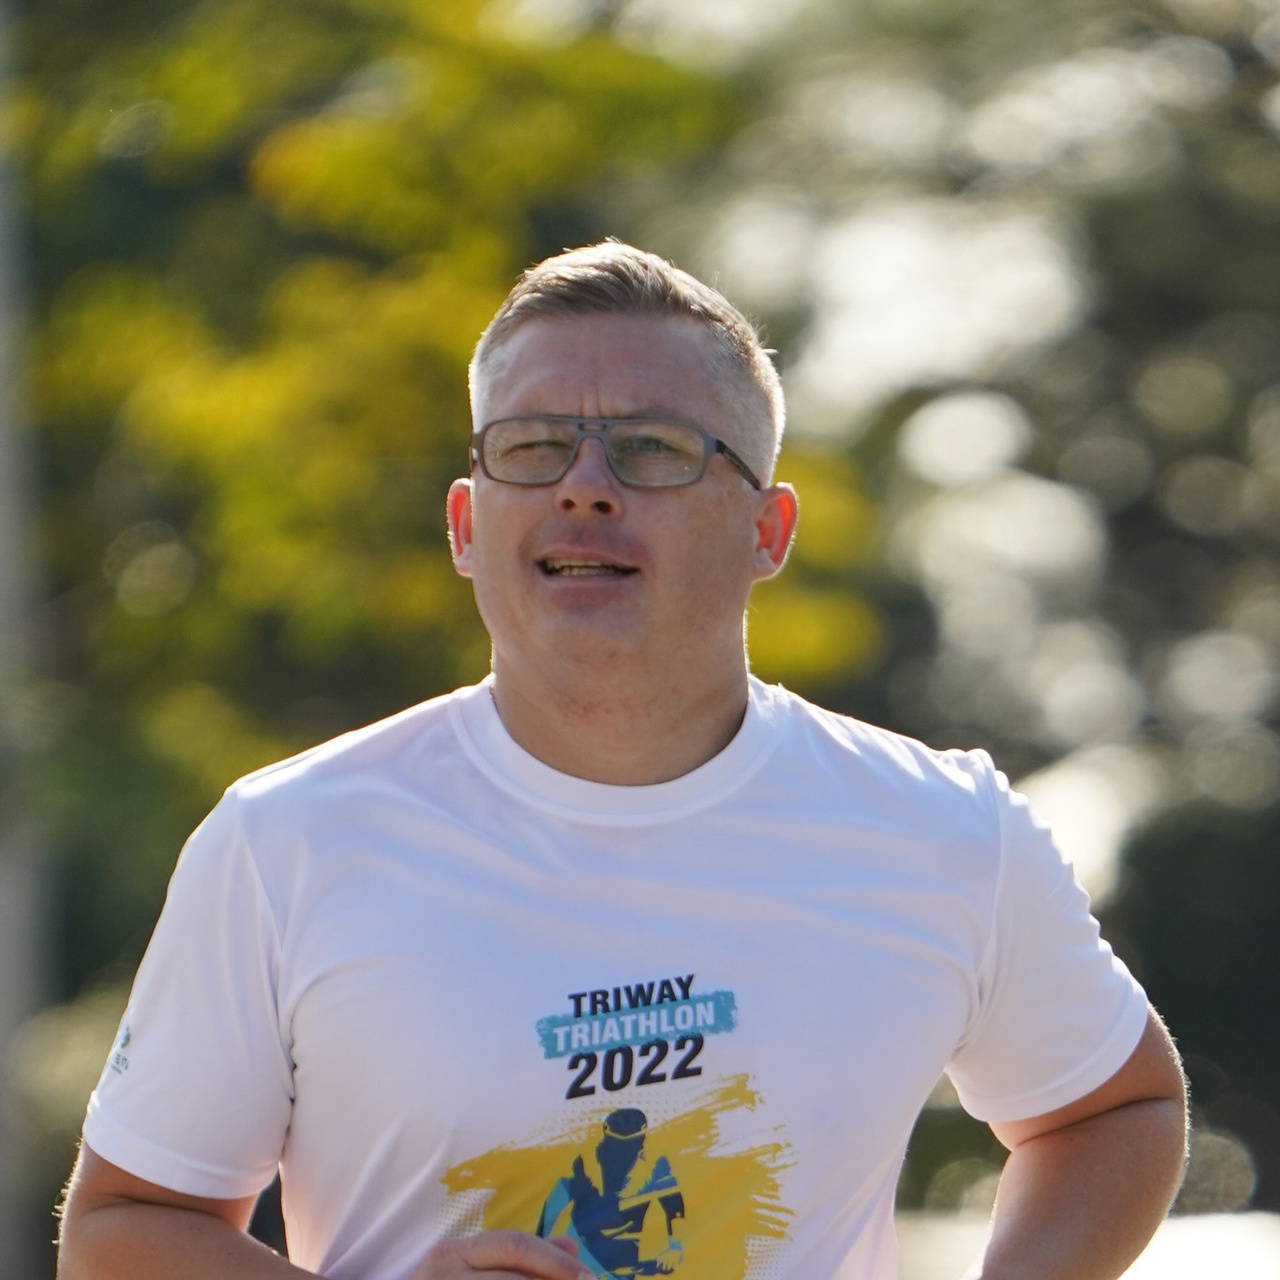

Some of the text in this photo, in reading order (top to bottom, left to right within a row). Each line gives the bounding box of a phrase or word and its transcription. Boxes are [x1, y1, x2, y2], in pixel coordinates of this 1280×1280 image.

[568, 973, 695, 1019] TRIWAY
[552, 1000, 715, 1052] TRIATHLON
[565, 1034, 705, 1100] 2022
